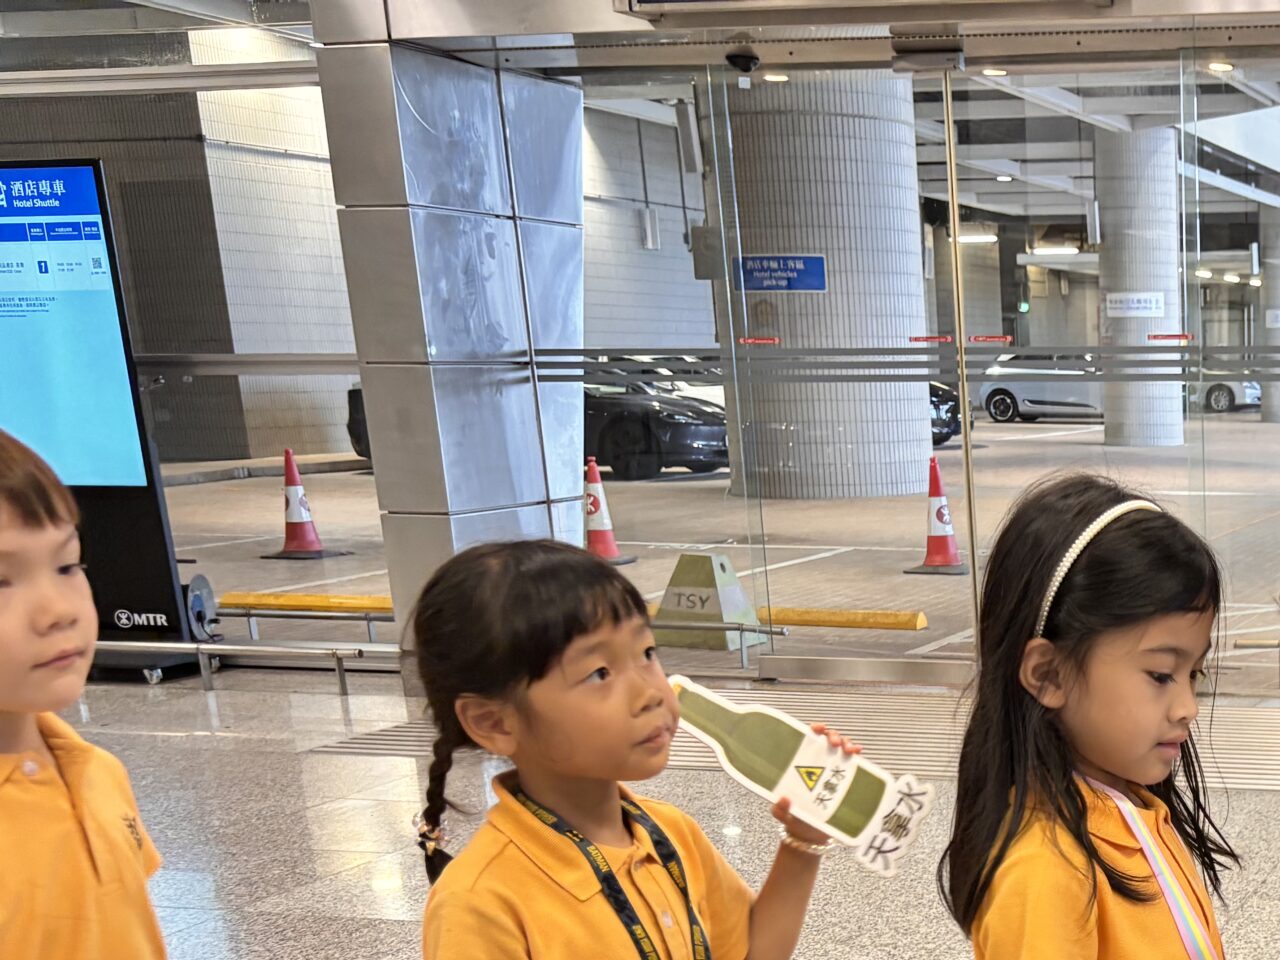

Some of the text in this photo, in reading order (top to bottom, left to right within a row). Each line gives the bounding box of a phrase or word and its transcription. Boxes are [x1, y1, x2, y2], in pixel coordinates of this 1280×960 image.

[10, 180, 66, 196] 酒店專車
[13, 198, 60, 207] Hotel Shuttle
[771, 270, 797, 279] vehicles
[672, 592, 711, 610] TSY
[133, 613, 168, 627] MTR
[586, 845, 611, 873] BATMAN
